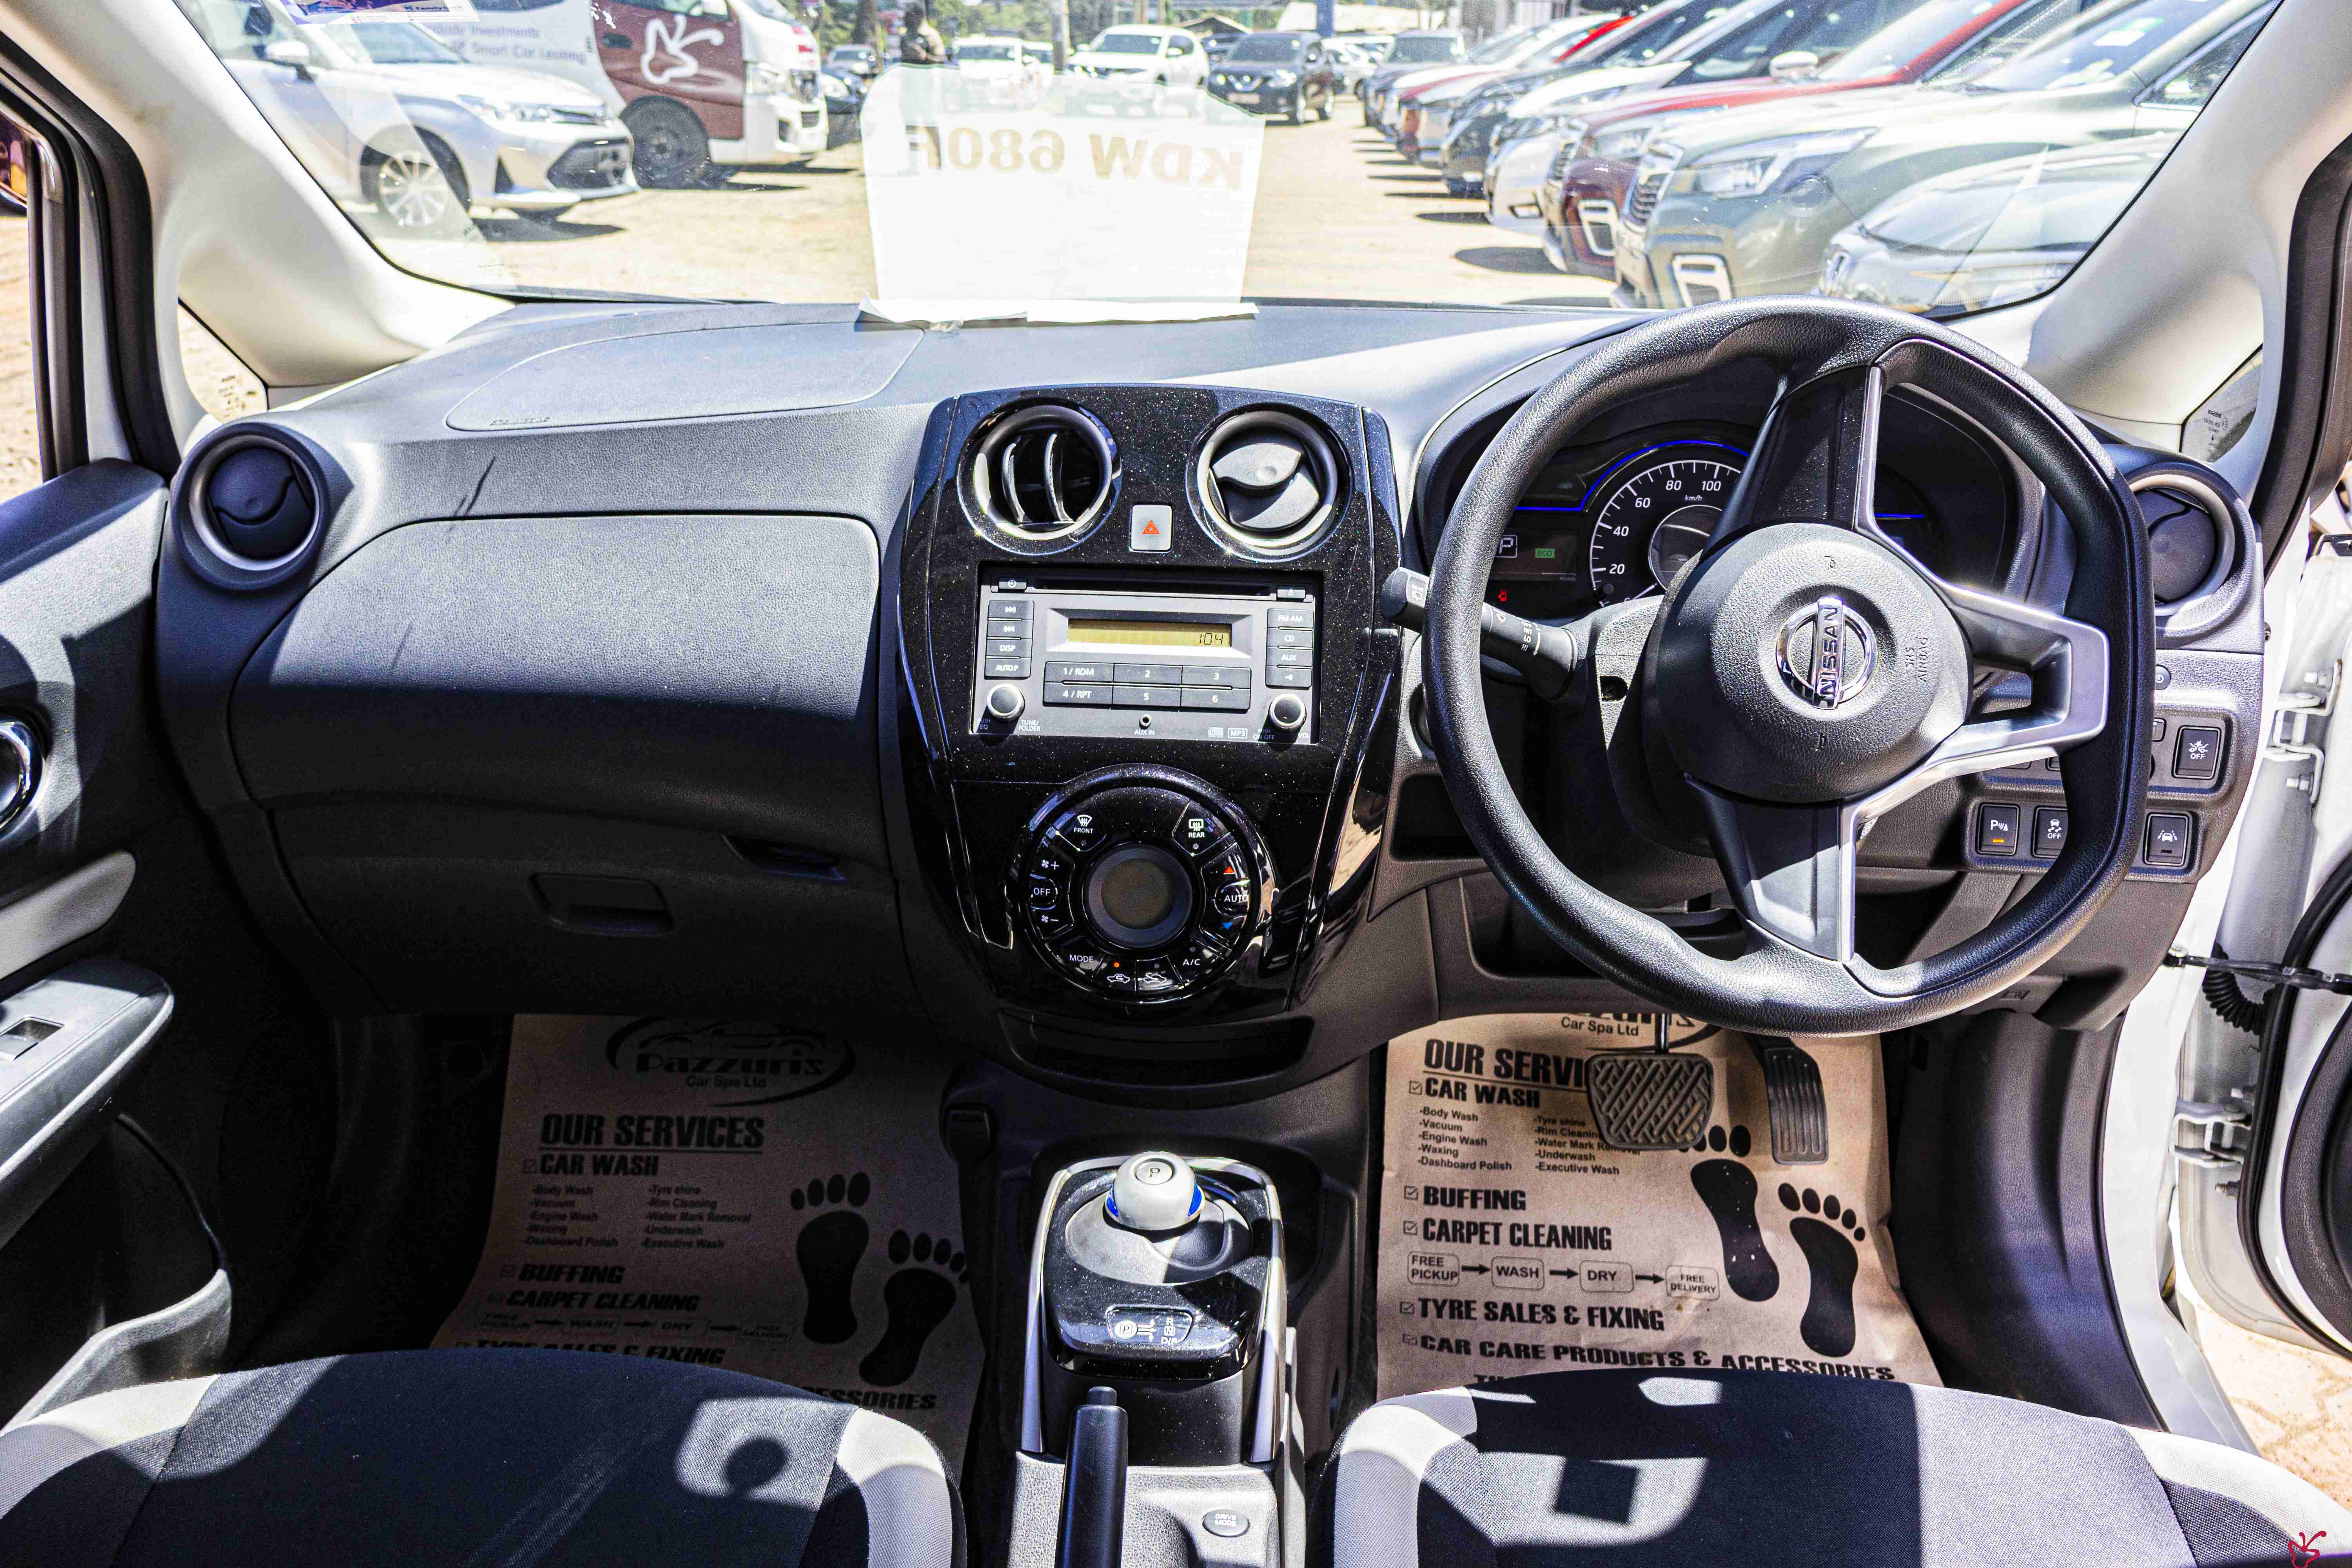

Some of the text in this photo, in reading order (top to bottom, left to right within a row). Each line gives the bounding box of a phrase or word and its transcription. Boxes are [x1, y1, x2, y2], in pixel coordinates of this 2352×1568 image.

[1666, 480, 1682, 490] 80
[1702, 481, 1721, 491] 100
[1635, 497, 1651, 508] 60
[1613, 526, 1629, 536] 40
[1499, 537, 1514, 554] P
[1609, 564, 1625, 574] 20
[1284, 634, 1295, 642] CD
[999, 644, 1016, 652] DISP
[1521, 643, 1529, 652] HI
[1819, 608, 1839, 695] NISSAN
[2047, 831, 2062, 839] OFF
[1033, 887, 1051, 897] OFF
[1224, 893, 1249, 902] AUTO
[1069, 953, 1094, 963] MODE
[1561, 1017, 1584, 1029] Car
[1587, 1020, 1614, 1035] Spa
[1617, 1024, 1639, 1036] Ltd
[637, 1049, 825, 1075] Pazzuris
[1424, 1038, 1589, 1087] OUR SERVI
[686, 1075, 767, 1089] Car Spa Ltd
[1425, 1077, 1540, 1109] CAR WASH
[1452, 1109, 1479, 1122] Wash
[541, 1114, 764, 1148] OUR SERVICES
[1560, 1128, 1598, 1138] Cleanin
[1460, 1135, 1487, 1146] Wash
[1570, 1140, 1594, 1149] Mark
[540, 1154, 659, 1176] CAR WASH
[1479, 1161, 1512, 1171] Polish
[1591, 1164, 1620, 1175] Wash
[1150, 1168, 1160, 1177] P
[564, 1185, 593, 1195] Wash
[674, 1185, 701, 1194] shine
[1423, 1185, 1526, 1210] BUFFING
[672, 1198, 717, 1211] Cleaning
[570, 1211, 598, 1221] Wash
[707, 1211, 751, 1223] Removal
[1423, 1218, 1612, 1250] CARPET CLEANING
[586, 1237, 618, 1247] Polish
[696, 1238, 724, 1249] Wash
[1412, 1255, 1444, 1268] FREE
[518, 1263, 625, 1284] BUFFING
[1411, 1269, 1458, 1281] PICKUP
[1496, 1266, 1539, 1278] WASH
[1588, 1270, 1617, 1281] DRY
[1680, 1274, 1704, 1283] FREE
[1670, 1283, 1716, 1294] DELIVERY
[506, 1290, 701, 1311] CARPET CLEANING
[1418, 1298, 1477, 1319] TYRE
[1484, 1302, 1556, 1323] SALES
[1588, 1307, 1664, 1331] FIXING
[661, 1321, 694, 1330] DRY
[645, 1345, 726, 1364] FIXING
[1420, 1335, 1471, 1355] CAR
[1479, 1341, 1546, 1359] CARE
[1553, 1345, 1686, 1367] PRODUCTS
[1721, 1355, 1895, 1381] ACCESSORIES
[802, 1386, 937, 1410] ESSORIES
